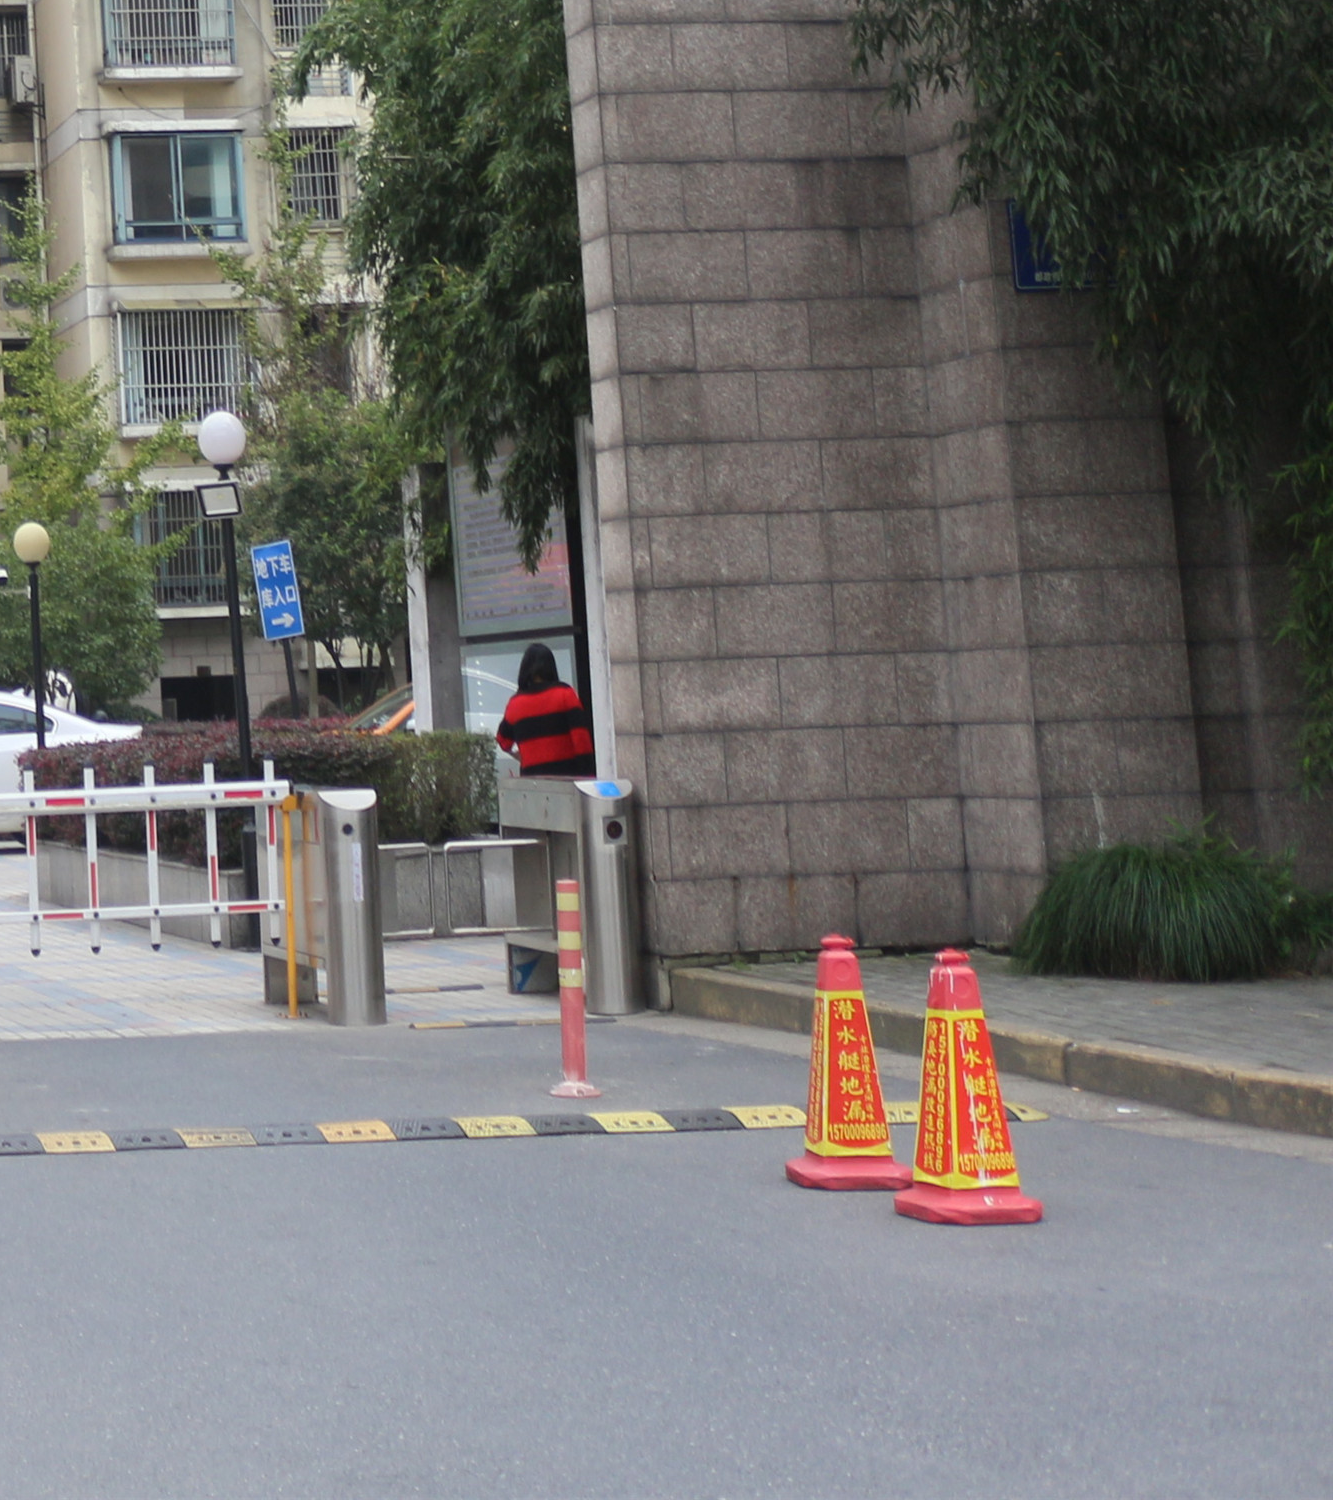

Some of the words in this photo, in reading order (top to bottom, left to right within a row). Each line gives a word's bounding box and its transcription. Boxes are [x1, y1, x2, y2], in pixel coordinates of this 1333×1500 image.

[255, 553, 292, 579] 地下车
[261, 585, 296, 609] 库入口
[833, 999, 866, 1122] 潜水艇地漏
[935, 1021, 946, 1173] 15700096896
[829, 1123, 887, 1140] 15700096896
